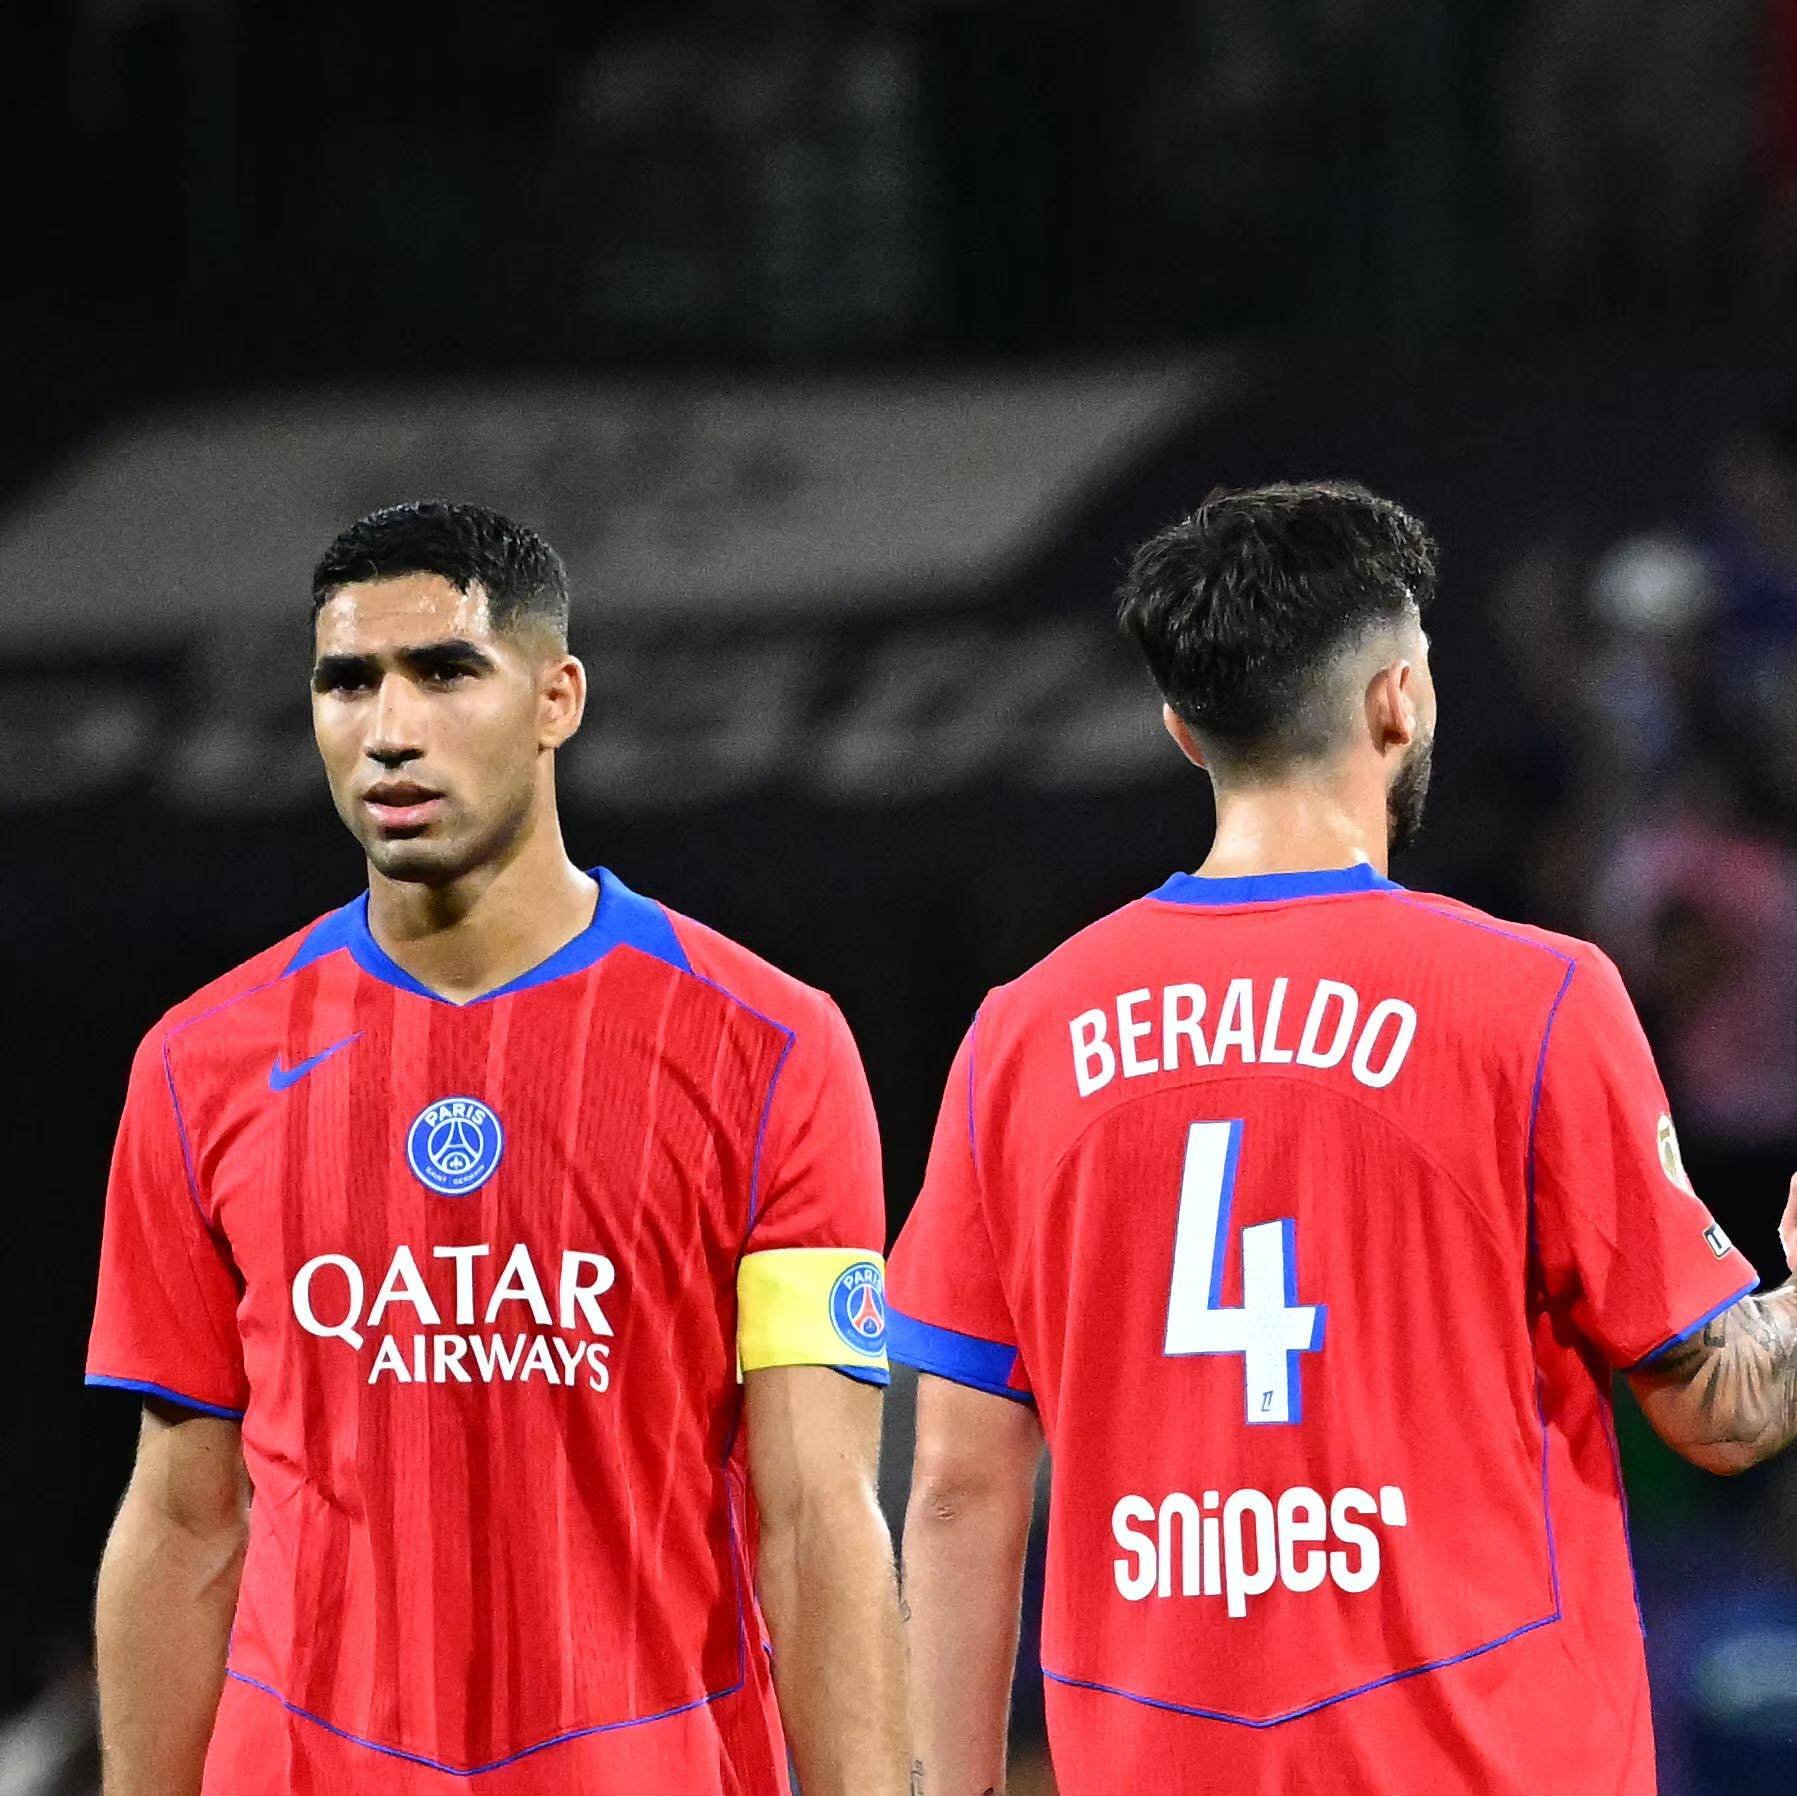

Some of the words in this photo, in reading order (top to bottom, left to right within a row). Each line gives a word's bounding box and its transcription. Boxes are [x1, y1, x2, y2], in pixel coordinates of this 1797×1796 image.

[1068, 976, 1417, 1098] BERALDO
[424, 1103, 487, 1128] PARIS
[292, 1243, 616, 1351] QATAR
[1164, 1119, 1322, 1424] 4
[368, 1333, 610, 1393] AIRWAYS
